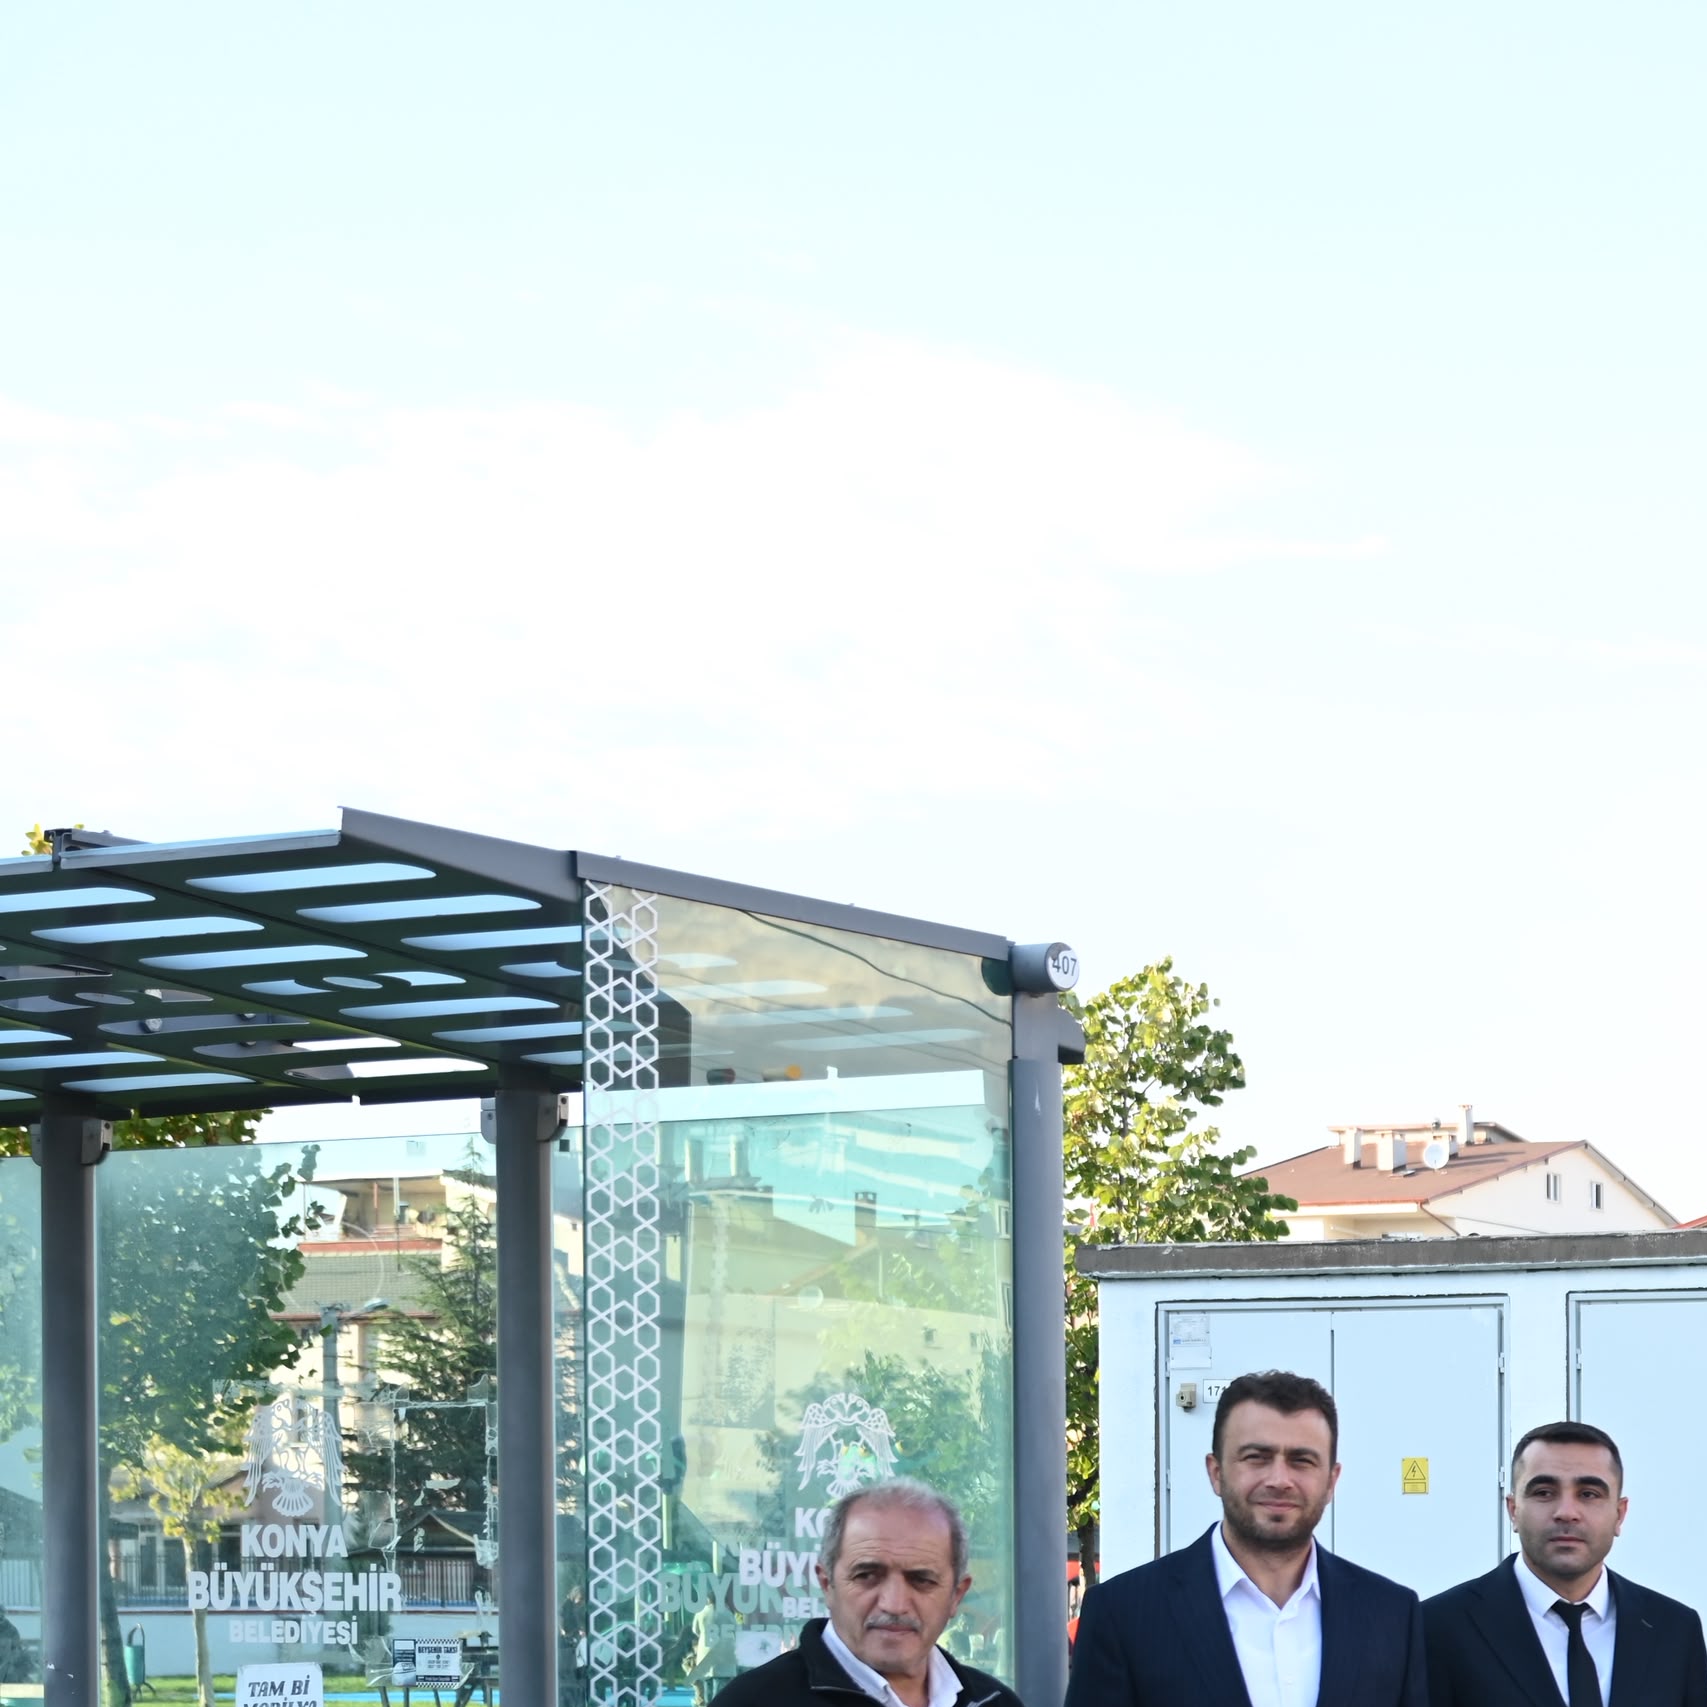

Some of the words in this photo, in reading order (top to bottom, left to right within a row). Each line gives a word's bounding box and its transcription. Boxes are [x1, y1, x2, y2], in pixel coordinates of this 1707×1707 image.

[241, 1523, 349, 1558] KONYA
[188, 1562, 402, 1617] BÜYÜKŞEHİR
[248, 1680, 286, 1697] TAM
[291, 1674, 310, 1695] Bİ
